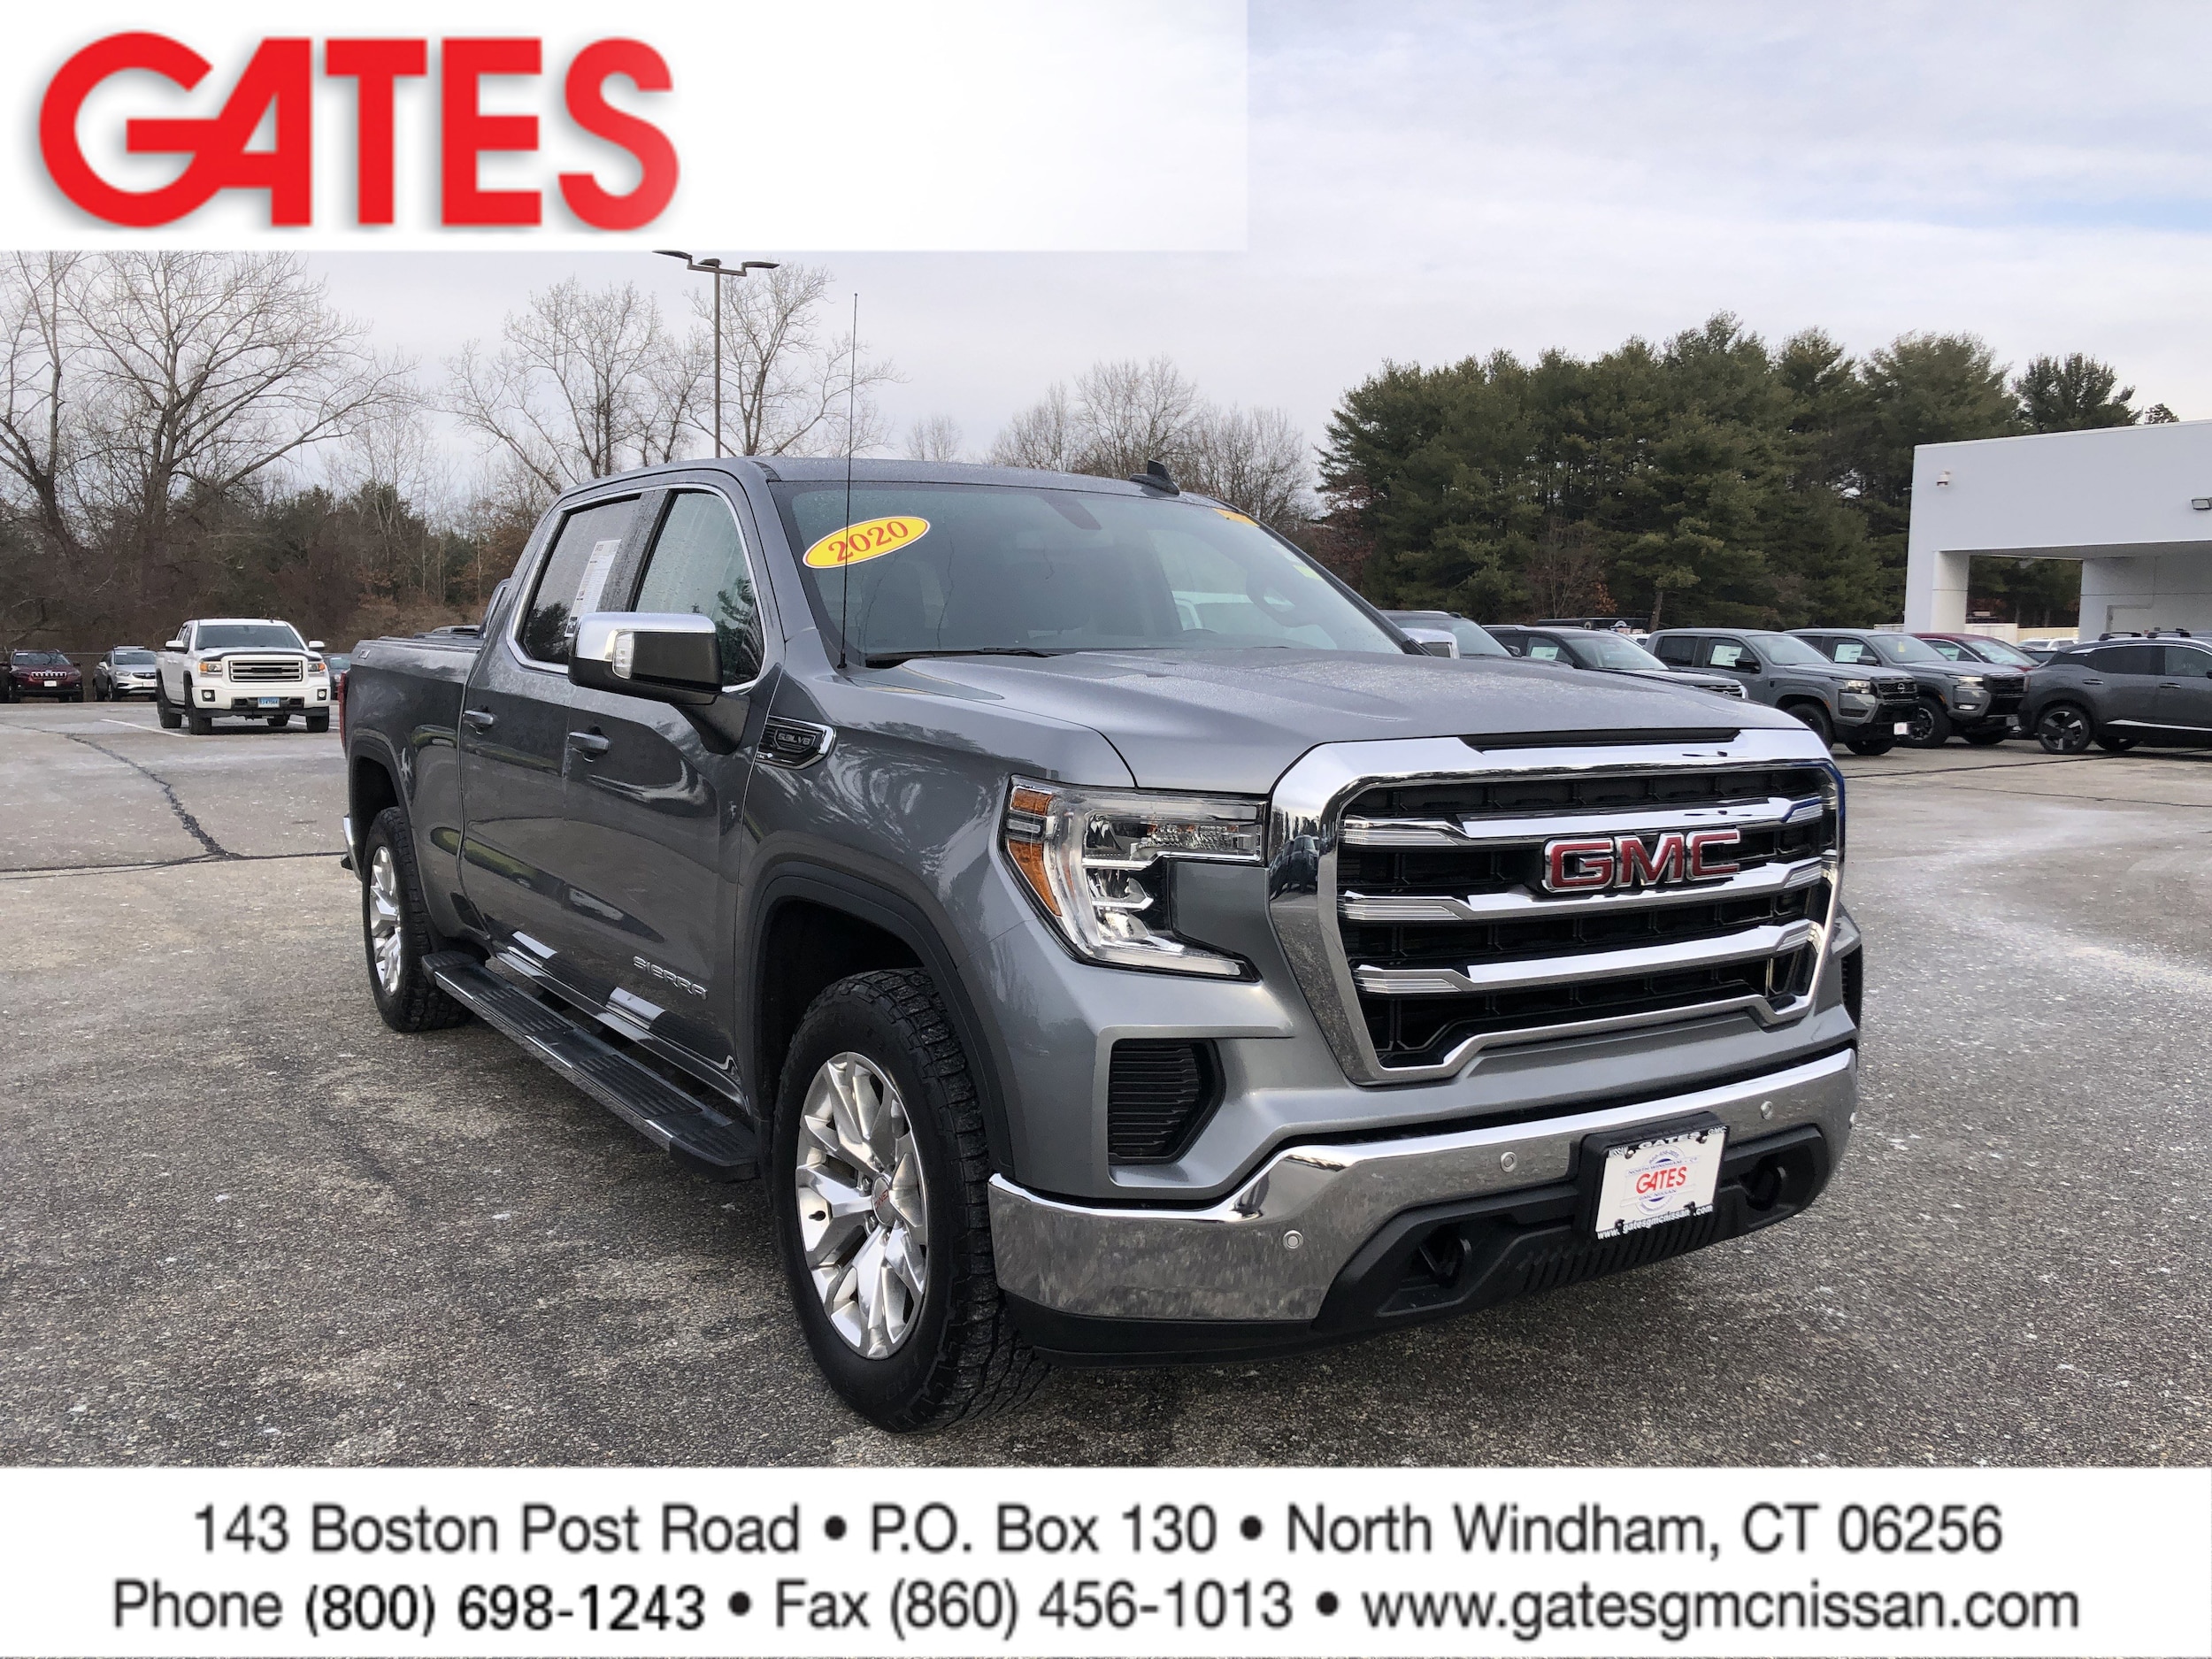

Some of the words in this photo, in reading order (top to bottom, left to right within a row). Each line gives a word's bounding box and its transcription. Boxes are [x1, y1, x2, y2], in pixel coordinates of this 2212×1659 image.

[828, 521, 909, 562] 2020
[1542, 829, 1741, 893] GMC
[633, 956, 707, 1000] SIERRA
[1638, 1131, 1701, 1149] GATES
[1636, 1166, 1687, 1194] GATES
